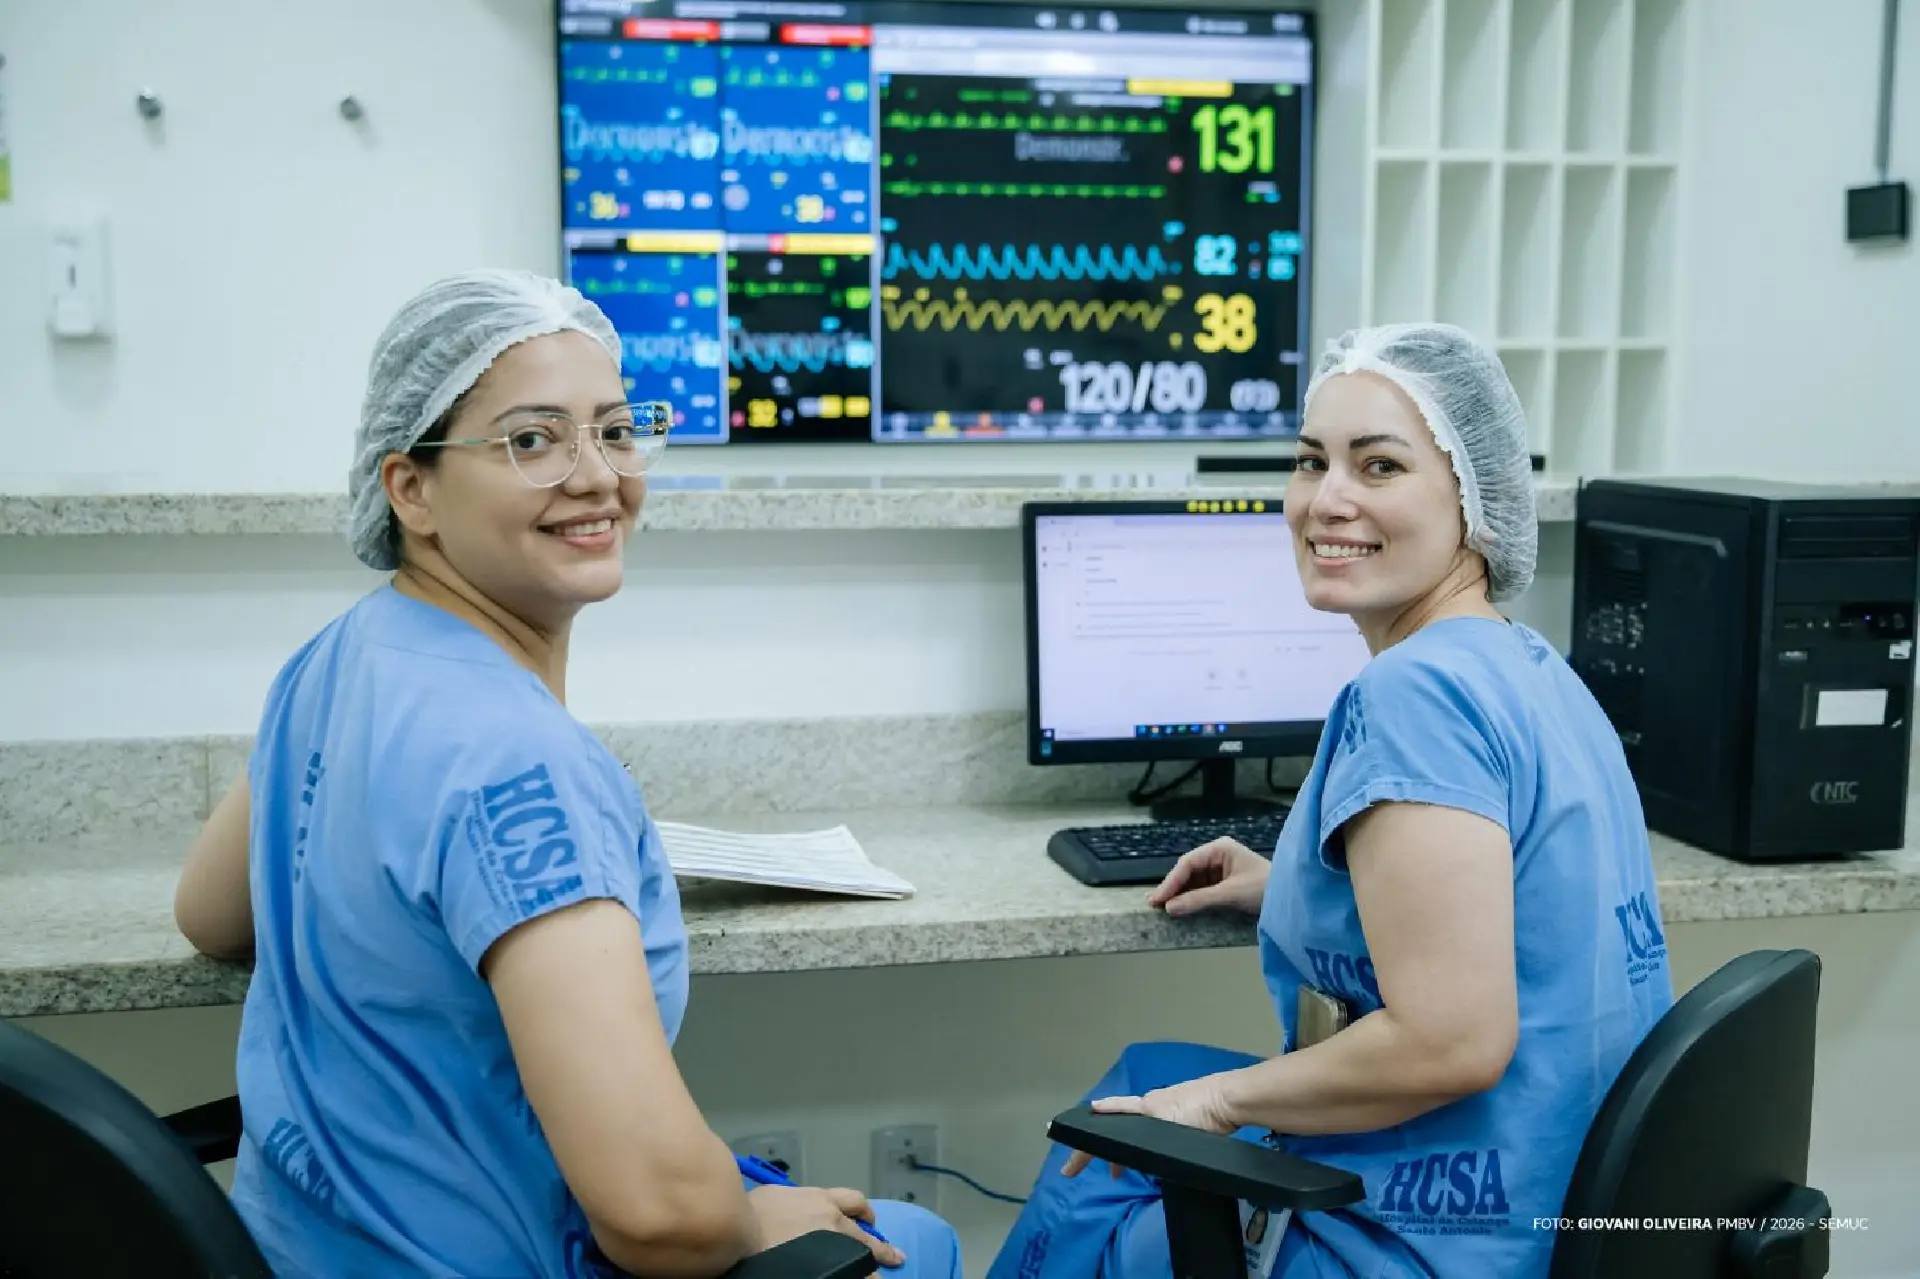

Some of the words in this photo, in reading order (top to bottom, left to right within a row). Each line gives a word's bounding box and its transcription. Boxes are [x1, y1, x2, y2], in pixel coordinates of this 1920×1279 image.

[1191, 104, 1276, 173] 131
[1194, 234, 1238, 275] 82
[1194, 293, 1257, 353] 38
[1059, 361, 1207, 414] 120/80
[1304, 945, 1380, 1001] HCS
[1379, 1150, 1511, 1216] HCSA
